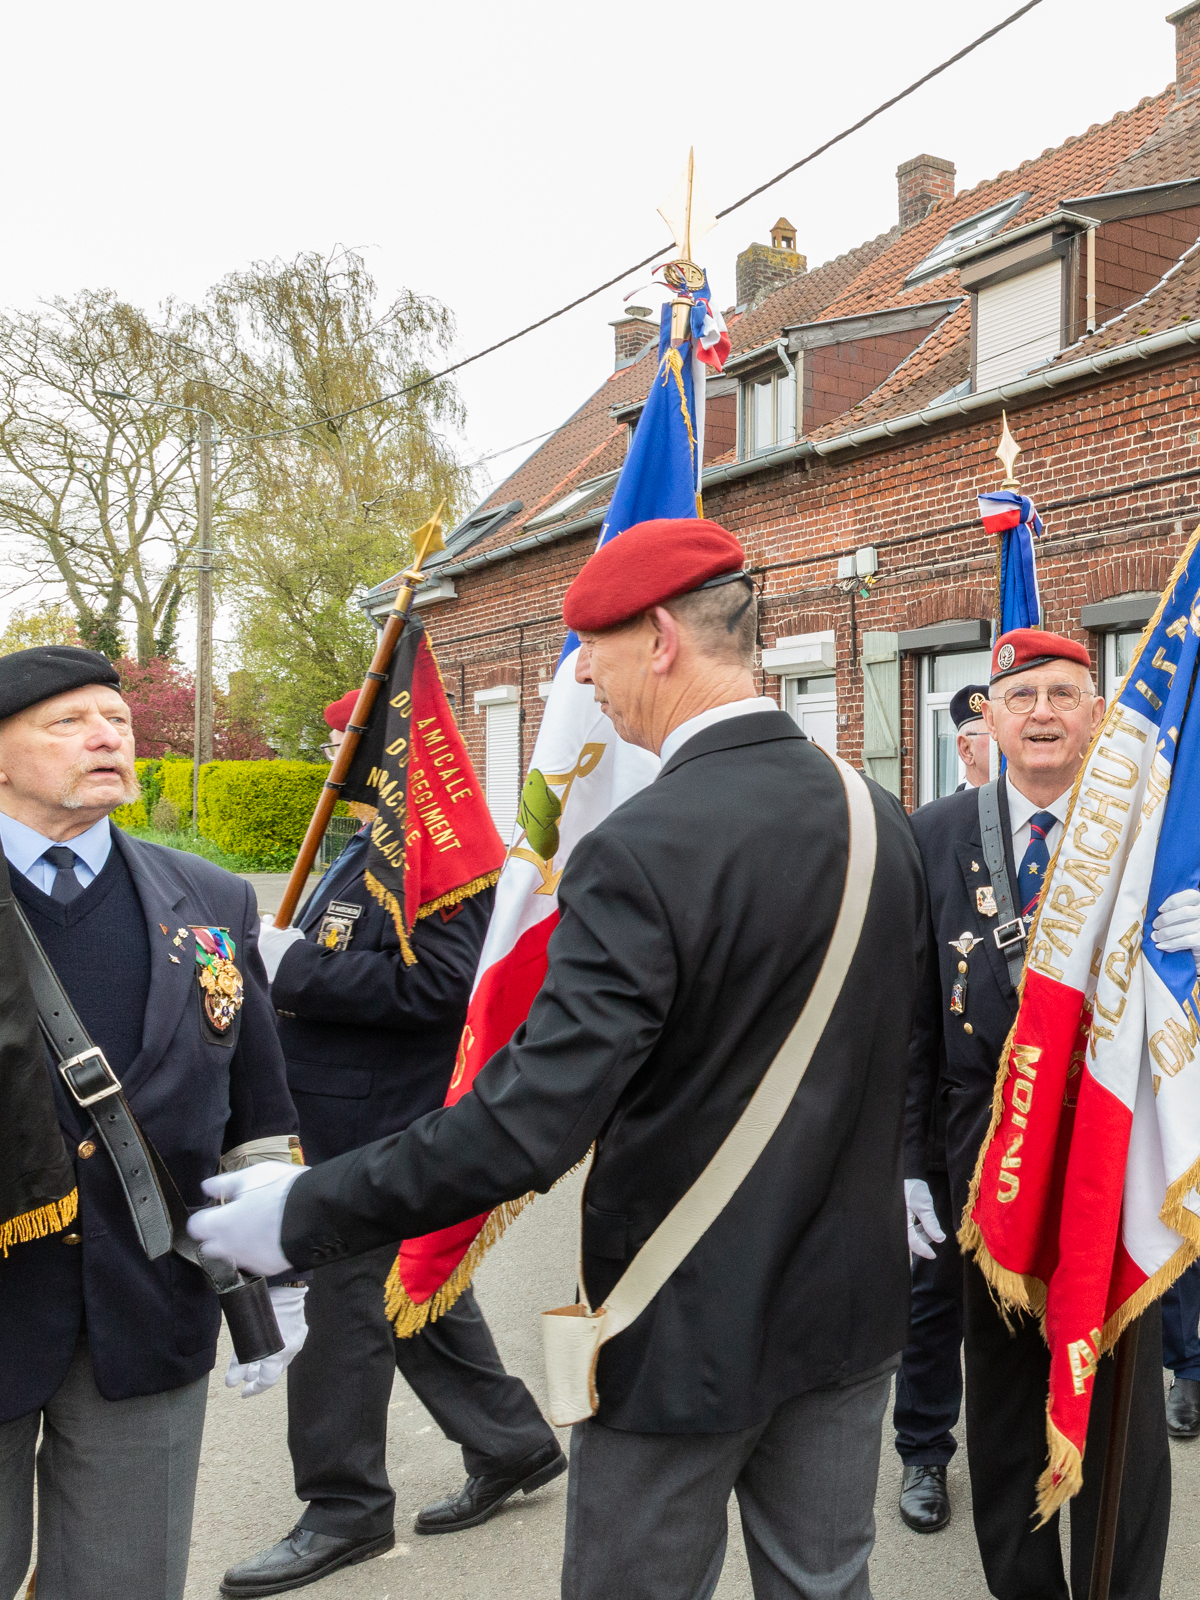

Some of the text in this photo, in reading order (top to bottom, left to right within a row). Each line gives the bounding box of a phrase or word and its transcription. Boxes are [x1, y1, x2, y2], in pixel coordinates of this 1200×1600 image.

[390, 691, 413, 719] DU
[416, 717, 473, 804] AMICALE
[409, 769, 461, 853] REGIMENT
[996, 1043, 1043, 1204] UNION
